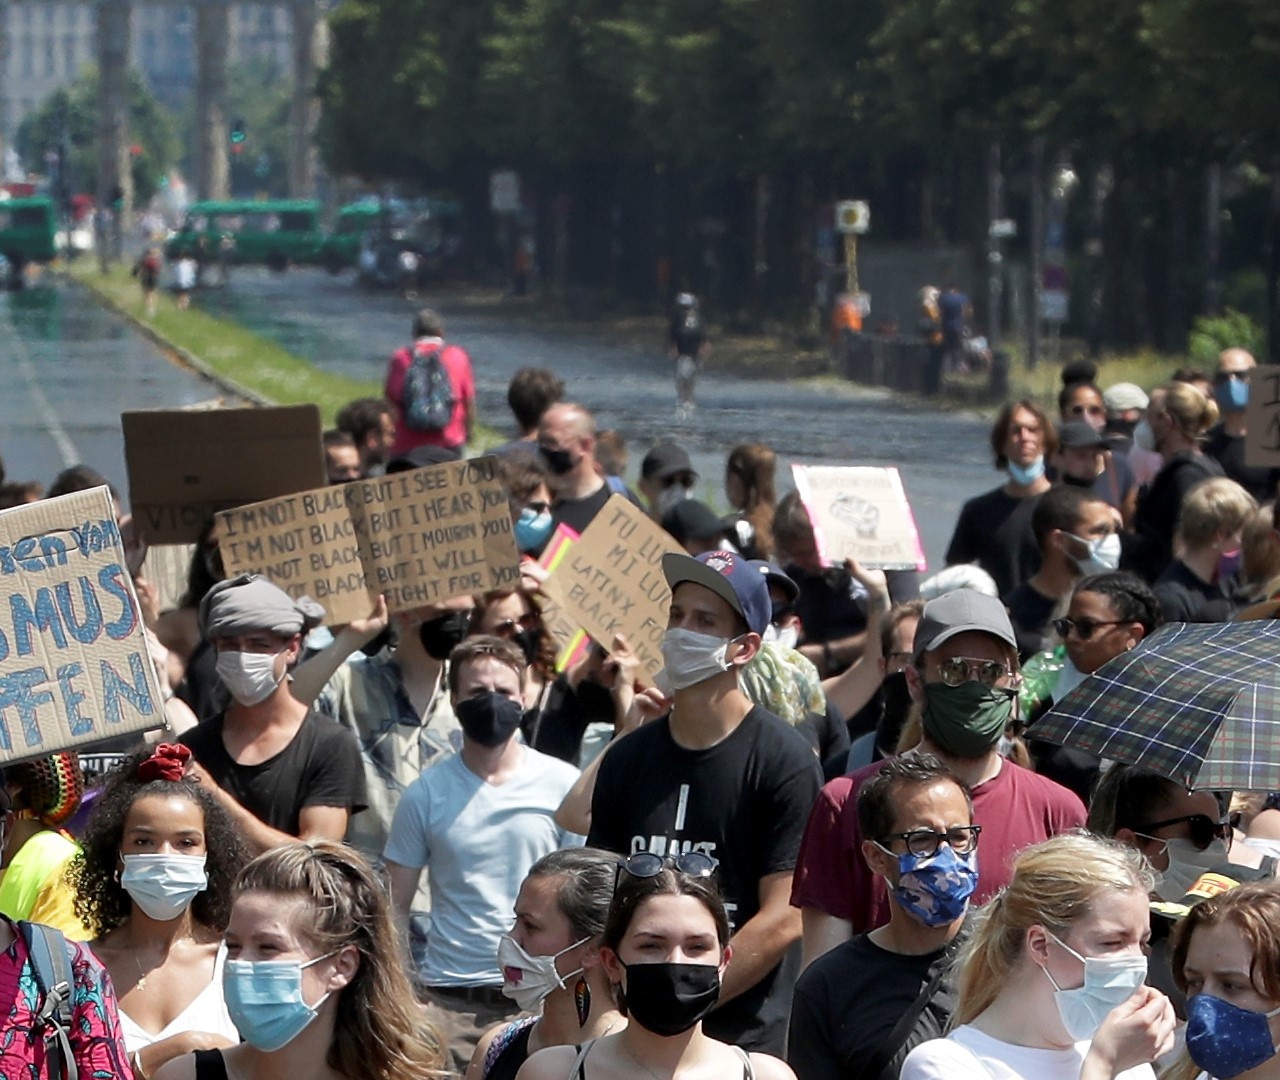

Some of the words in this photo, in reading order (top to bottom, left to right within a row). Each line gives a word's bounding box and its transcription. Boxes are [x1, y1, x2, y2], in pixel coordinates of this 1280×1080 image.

[260, 498, 297, 527] NOT
[363, 477, 394, 504] BUT
[400, 475, 411, 498] I
[415, 469, 448, 493] SEE
[456, 460, 495, 486] YOU
[270, 527, 306, 556] NOT
[371, 507, 406, 534] BUT
[410, 503, 420, 526] I
[370, 535, 406, 561] BUT
[410, 531, 419, 554] I
[377, 559, 409, 585] BUT
[417, 558, 426, 577] I
[433, 548, 486, 571] WILL
[448, 573, 484, 595] FOR
[570, 555, 636, 617] LATINX
[568, 583, 623, 636] BLACK
